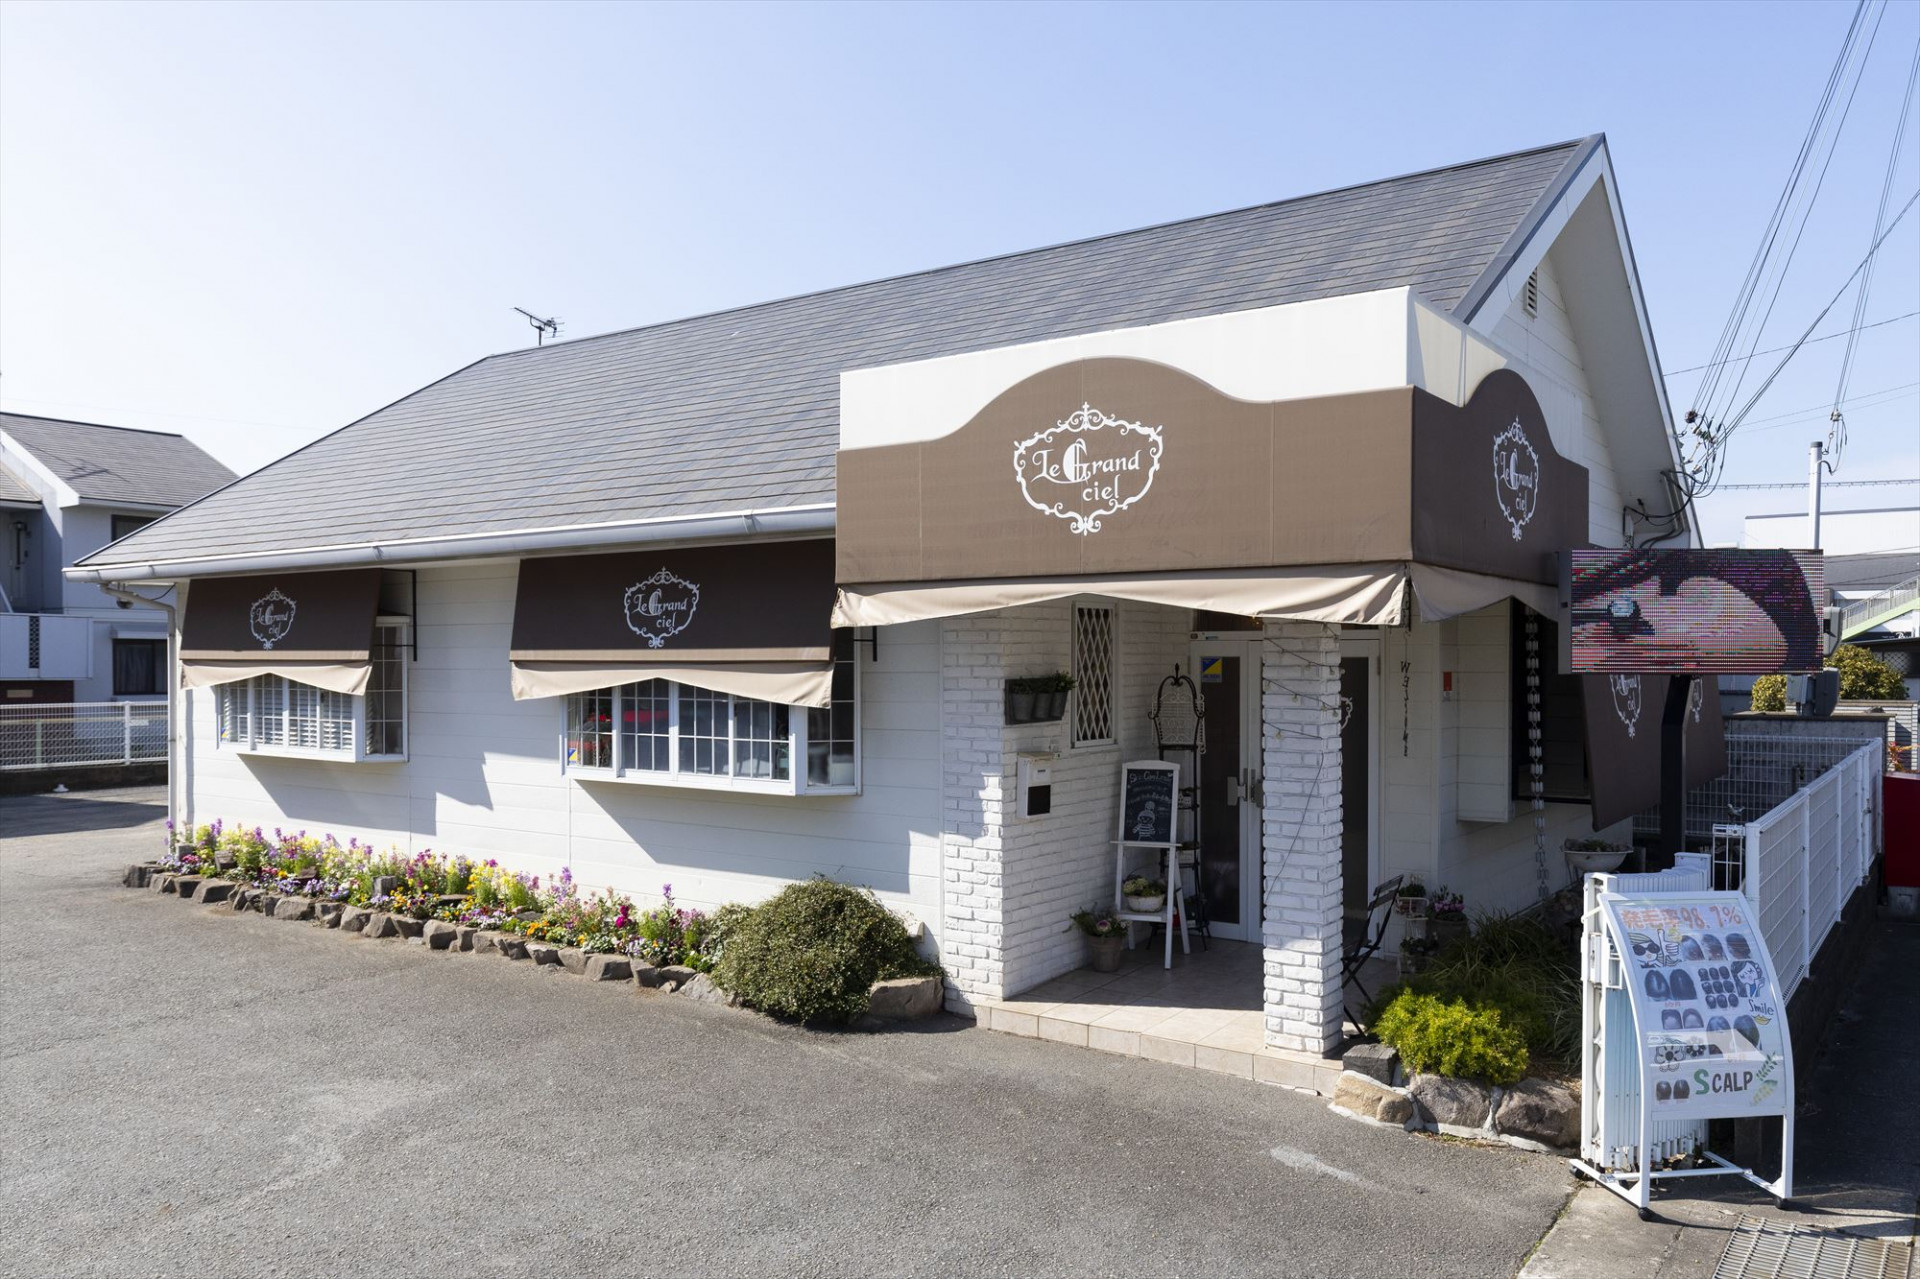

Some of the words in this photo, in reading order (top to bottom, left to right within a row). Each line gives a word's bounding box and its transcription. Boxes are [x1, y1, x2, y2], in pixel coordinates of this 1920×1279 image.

[1031, 449, 1061, 484] Le
[1062, 438, 1142, 484] Grand
[1082, 474, 1120, 501] ciel
[648, 588, 688, 616] Grand
[656, 612, 676, 628] ciel
[1749, 999, 1775, 1016] Smile
[1694, 1068, 1753, 1095] SCALP
